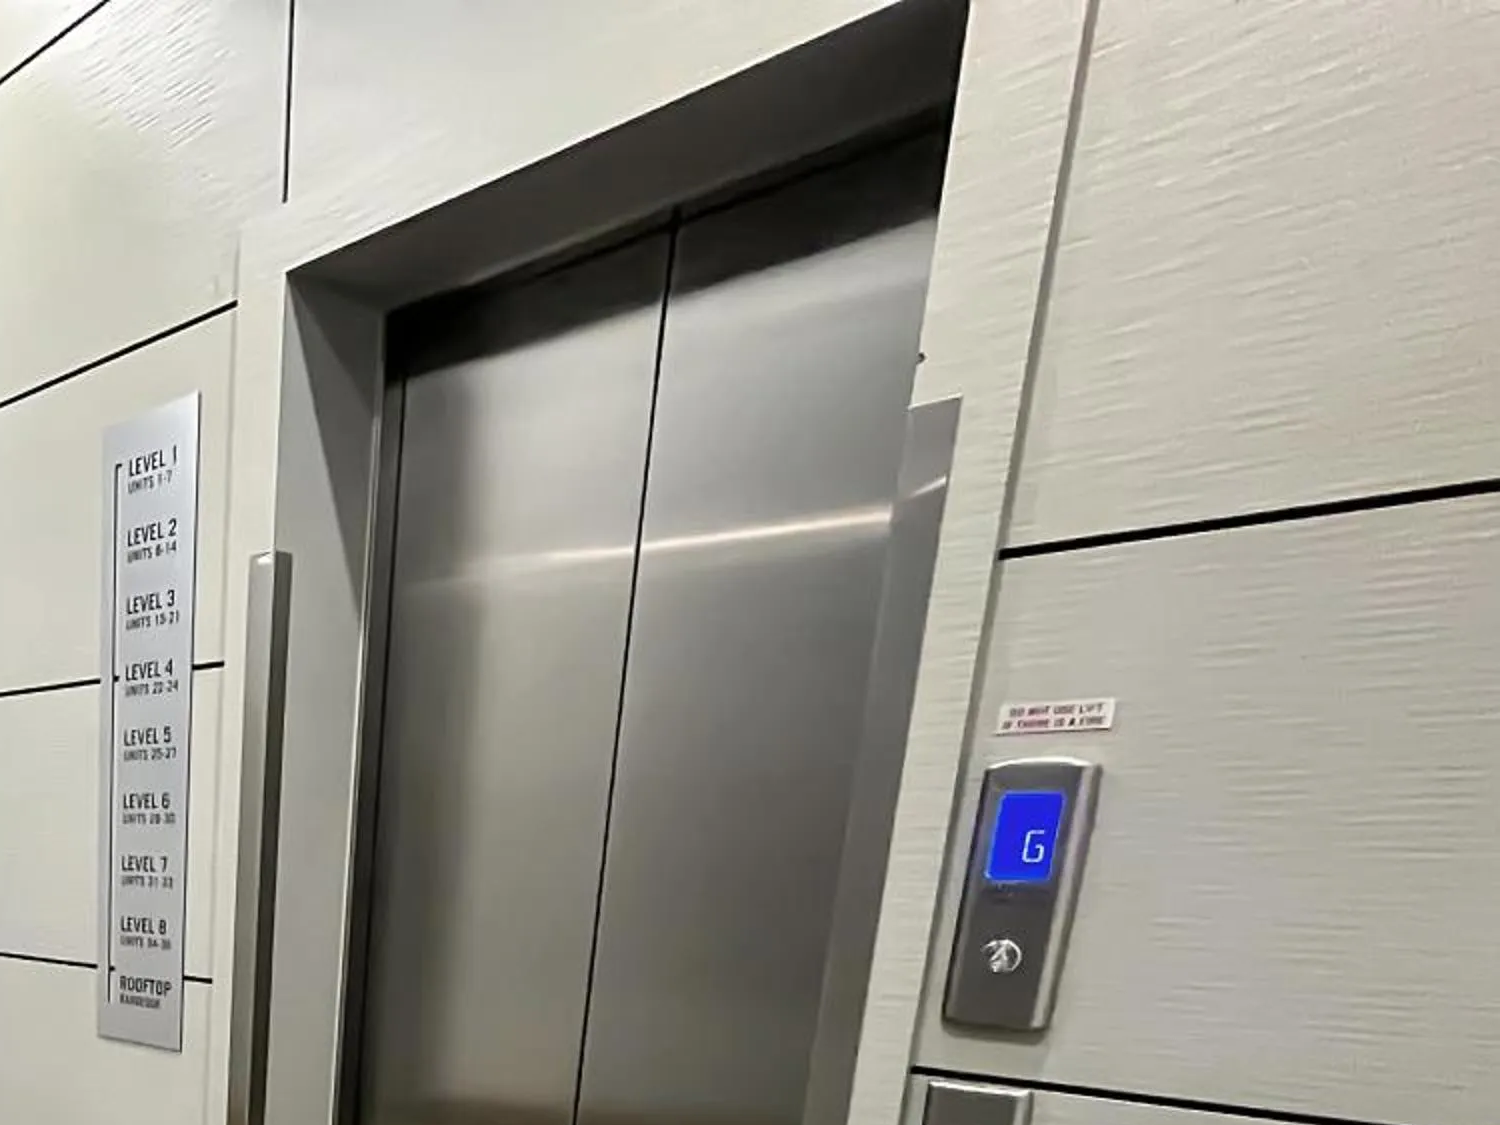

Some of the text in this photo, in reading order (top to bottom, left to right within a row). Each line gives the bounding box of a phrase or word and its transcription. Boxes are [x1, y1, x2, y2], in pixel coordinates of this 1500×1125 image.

[129, 445, 178, 477] LEVEL 1
[128, 475, 154, 494] UNITS
[127, 518, 177, 547] LEVEL 2
[127, 547, 153, 564] UNITS
[127, 589, 175, 615] LEVEL 3
[126, 615, 151, 630] UNITS
[125, 658, 173, 682] LEVEL 4
[125, 683, 149, 697] UNITS
[124, 726, 171, 747] LEVEL 5
[124, 748, 148, 761] UNITS
[123, 791, 170, 809] LEVEL 6
[122, 812, 146, 825] UNITS
[1021, 829, 1046, 863] G
[121, 855, 167, 872] LEVEL 7
[121, 875, 145, 887] UNITS
[120, 915, 167, 935] LEVEL 8
[120, 935, 144, 948] UNITS
[119, 975, 173, 997] ROOFTOP
